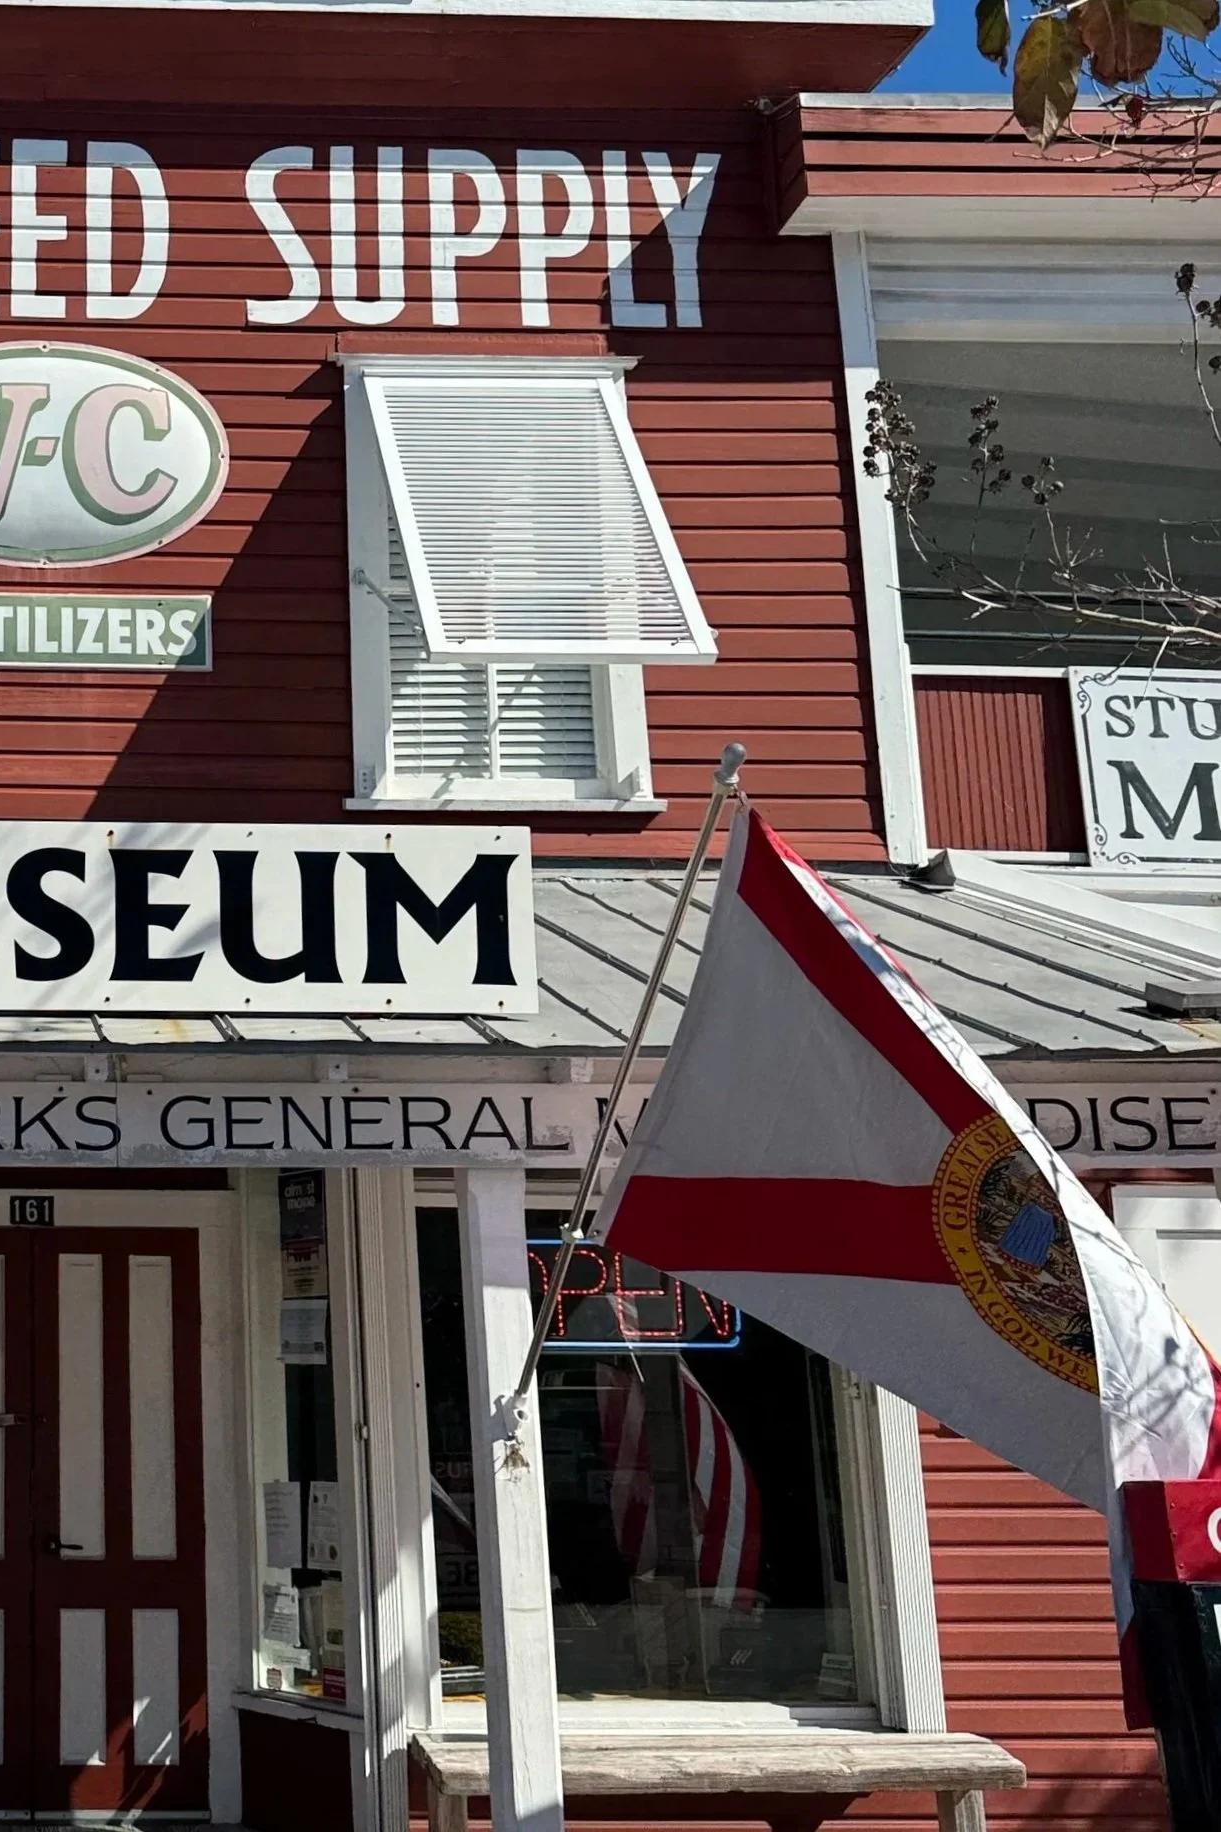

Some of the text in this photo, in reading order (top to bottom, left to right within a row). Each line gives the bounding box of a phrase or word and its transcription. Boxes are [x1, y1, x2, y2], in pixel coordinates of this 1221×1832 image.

[244, 146, 721, 328] SUPPLY
[1104, 695, 1221, 741] STU
[1106, 760, 1221, 841] M
[159, 1095, 571, 1151] GENERAL
[1025, 1096, 1217, 1152] DISE
[13, 1199, 50, 1223] 161
[943, 1144, 983, 1231] GREAT
[966, 1267, 1089, 1380] IN GOD WE
